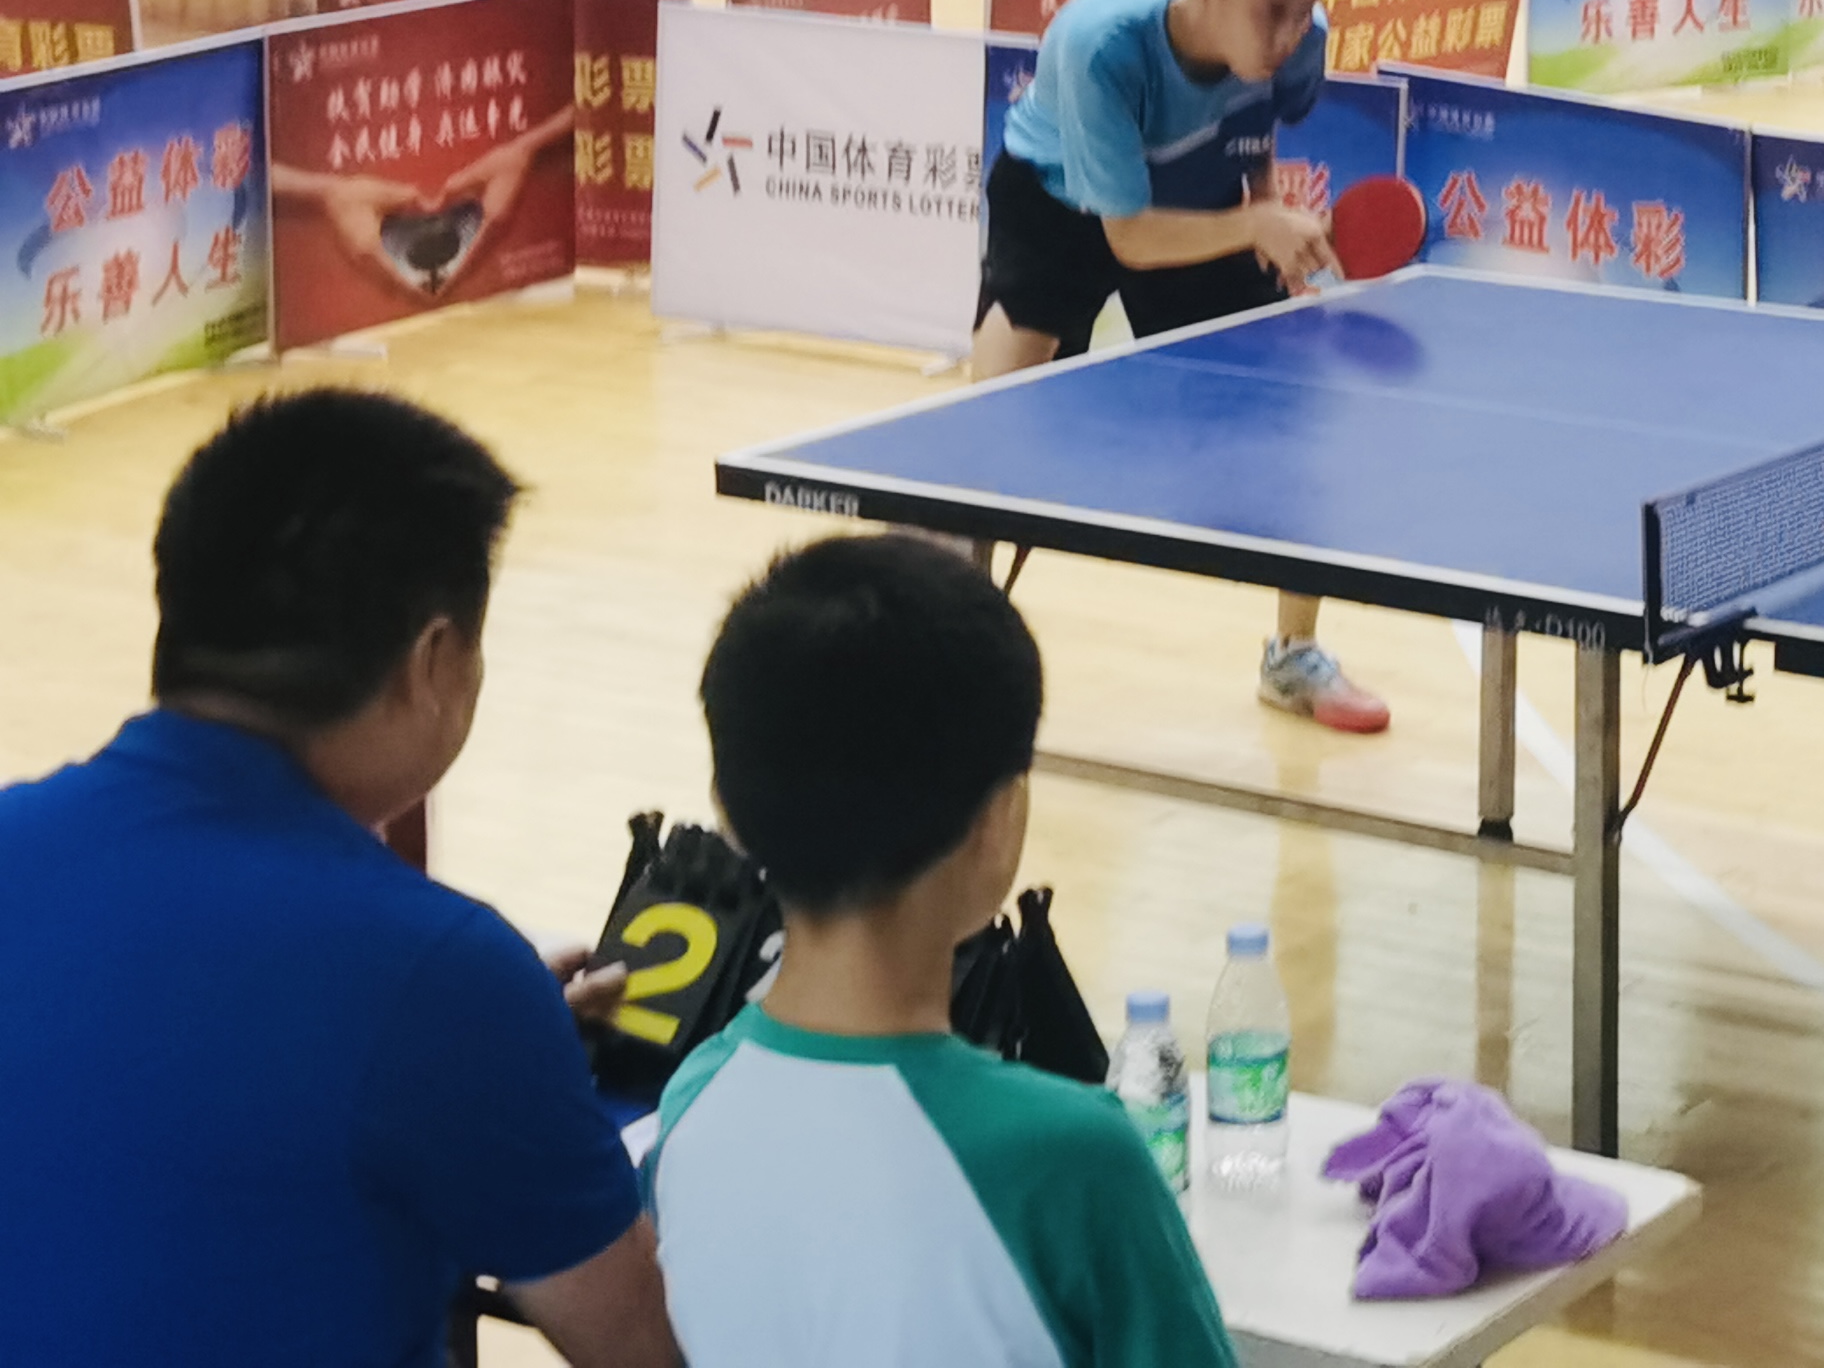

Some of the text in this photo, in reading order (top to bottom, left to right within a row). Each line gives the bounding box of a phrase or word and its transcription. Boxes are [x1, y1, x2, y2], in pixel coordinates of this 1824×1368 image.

[46, 121, 253, 233] 公益体彩
[765, 175, 823, 202] CHINA
[830, 183, 902, 213] SPORTS
[1437, 168, 1687, 280] 公益体彩
[41, 225, 243, 338] 乐善人生
[615, 901, 719, 1047] 2
